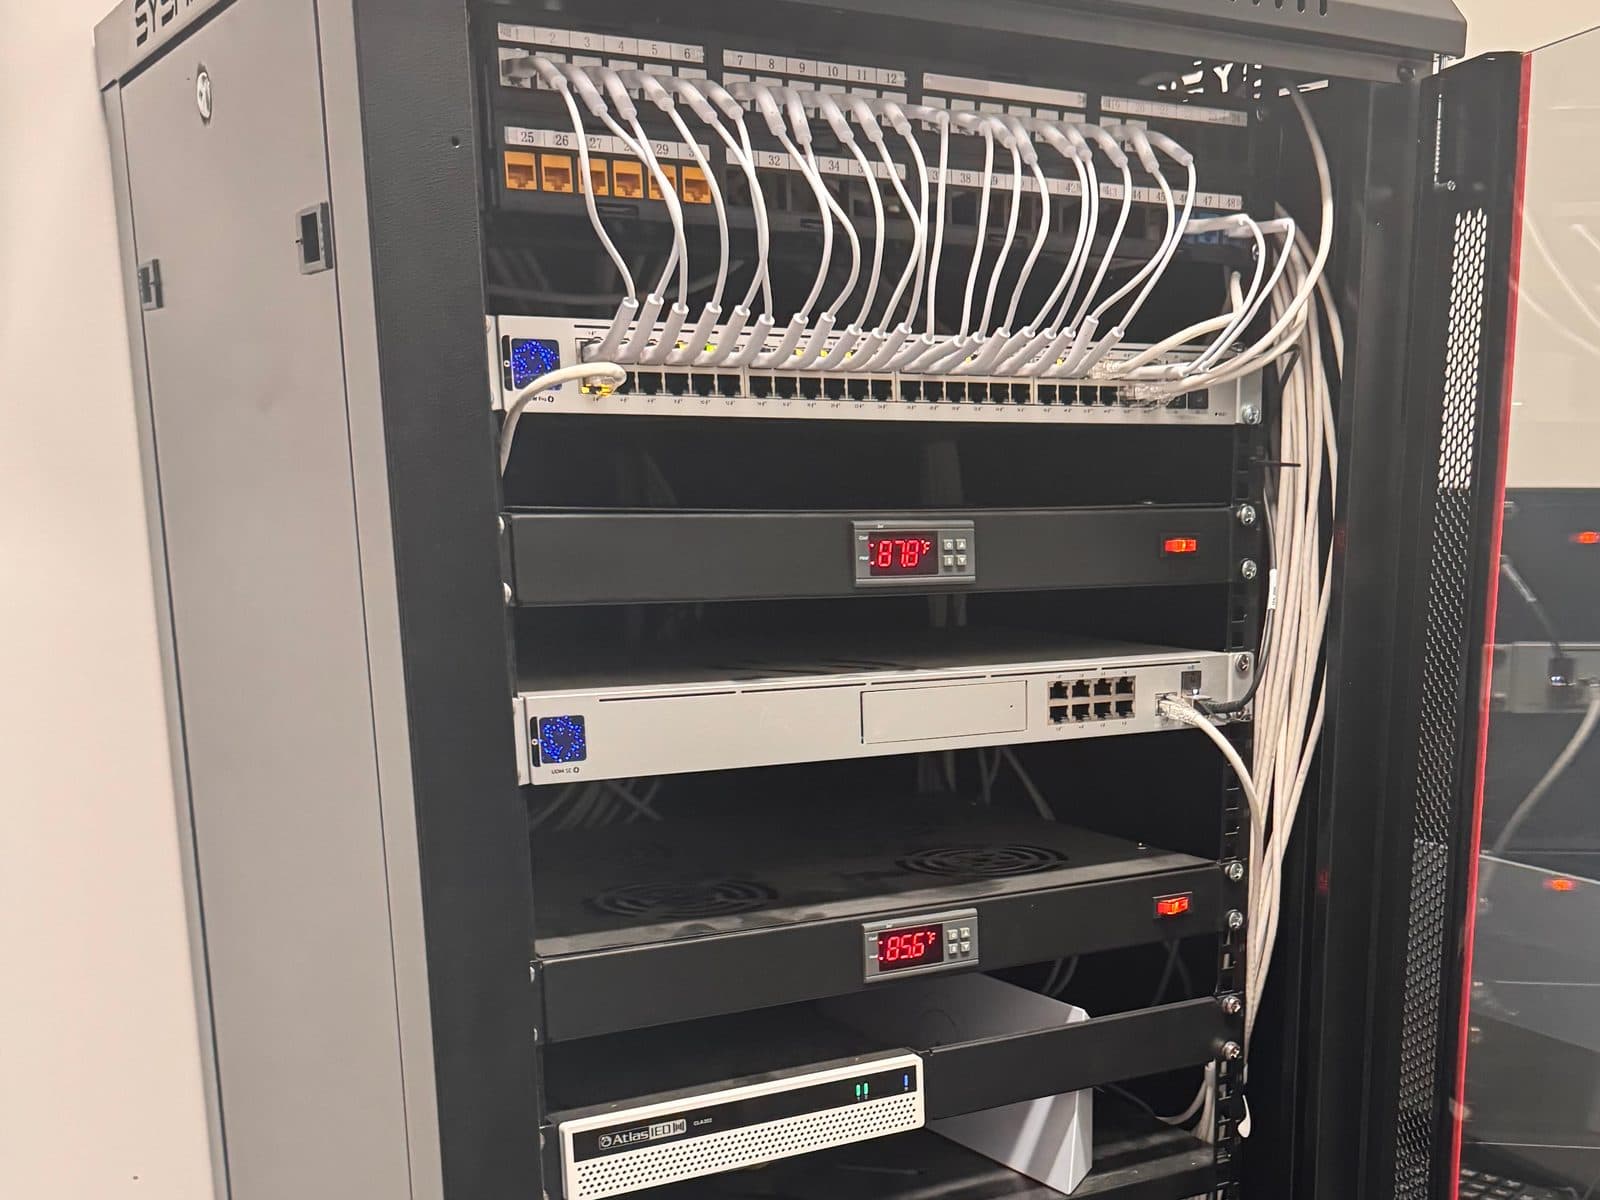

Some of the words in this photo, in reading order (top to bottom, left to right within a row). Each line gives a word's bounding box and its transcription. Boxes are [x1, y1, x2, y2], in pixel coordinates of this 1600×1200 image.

[548, 32, 557, 44] 2
[583, 36, 592, 48] 3
[616, 40, 626, 52] 4
[650, 43, 659, 56] 5
[683, 48, 692, 60] 6
[736, 54, 745, 66] 7
[768, 58, 776, 70] 8
[798, 62, 807, 74] 9
[826, 65, 840, 78] 10
[855, 69, 868, 82] 11
[885, 73, 898, 84] 12
[519, 131, 535, 144] 25
[554, 134, 570, 147] 26
[587, 137, 603, 150] 27
[655, 143, 670, 156] 29
[767, 154, 782, 167] 32
[827, 159, 841, 172] 34
[959, 173, 972, 184] 38
[1203, 195, 1214, 207] 47
